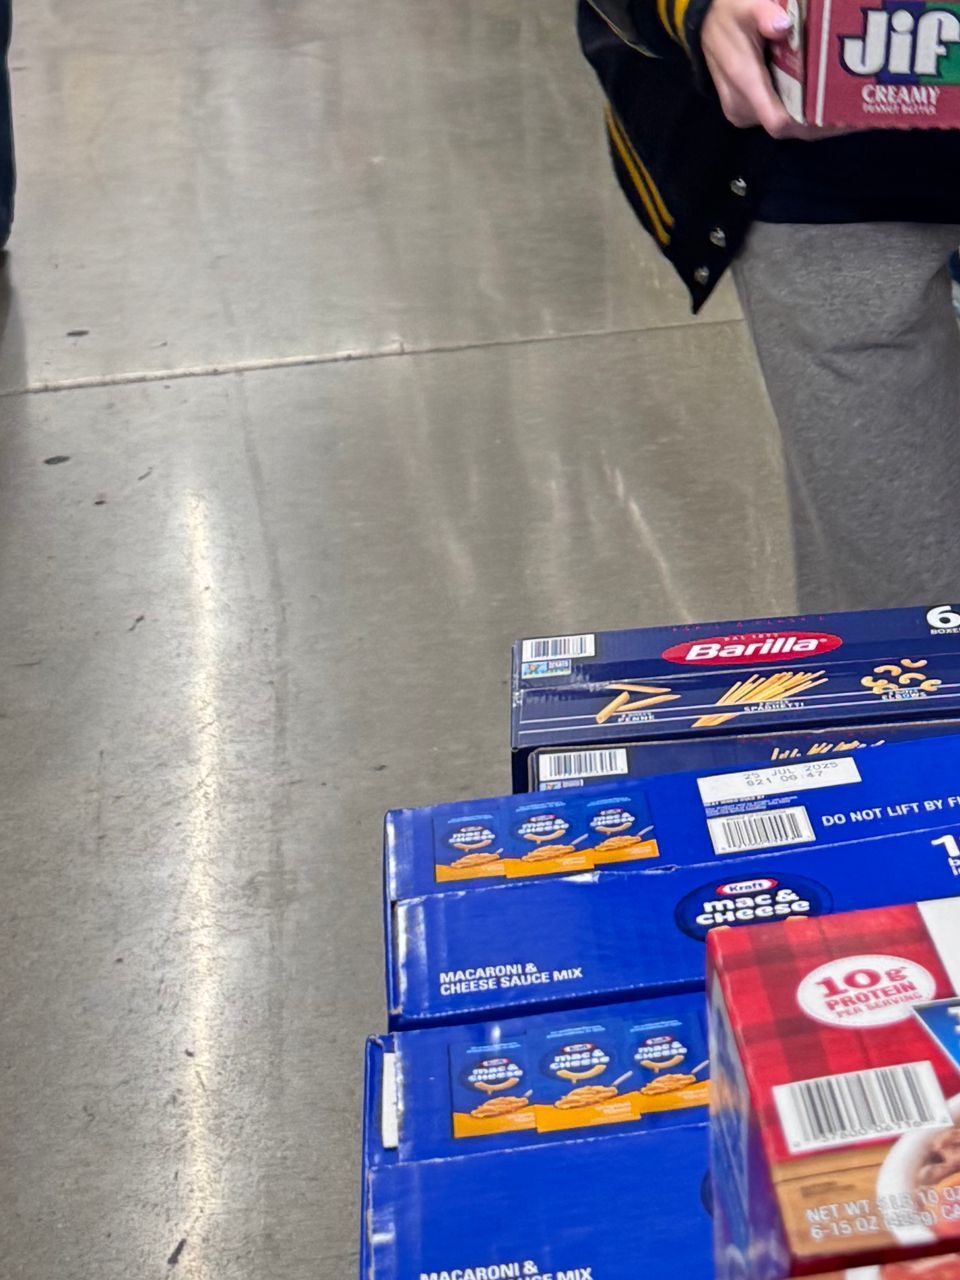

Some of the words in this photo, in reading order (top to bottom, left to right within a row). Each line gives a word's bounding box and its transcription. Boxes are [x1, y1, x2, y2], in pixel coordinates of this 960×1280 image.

[861, 83, 940, 107] CREAMY
[684, 635, 820, 661] Barilla
[742, 701, 805, 713] SPAGHETTI
[821, 813, 850, 826] DO
[853, 807, 884, 822] NOT
[886, 802, 921, 818] LIFT
[924, 797, 946, 812] BY
[729, 881, 764, 893] Kraft
[703, 893, 772, 912] mac
[775, 888, 800, 903] &
[439, 964, 523, 984] MACARONI
[525, 962, 538, 973] &
[440, 978, 497, 997] CHEESE
[500, 973, 550, 989] SAUCE
[553, 967, 584, 982] MIX
[814, 964, 910, 999] 10g
[825, 980, 917, 1011] PROTEIN
[835, 1006, 860, 1019] PER
[862, 992, 924, 1016] SERVING
[805, 1204, 837, 1223] NET
[846, 1199, 870, 1215] WT
[919, 1188, 938, 1205] 10
[809, 1222, 852, 1240] 6-15
[856, 1216, 878, 1233] OZ
[420, 1262, 520, 1280] MACARONI
[522, 1259, 539, 1275] &
[556, 1267, 595, 1280] MIX
